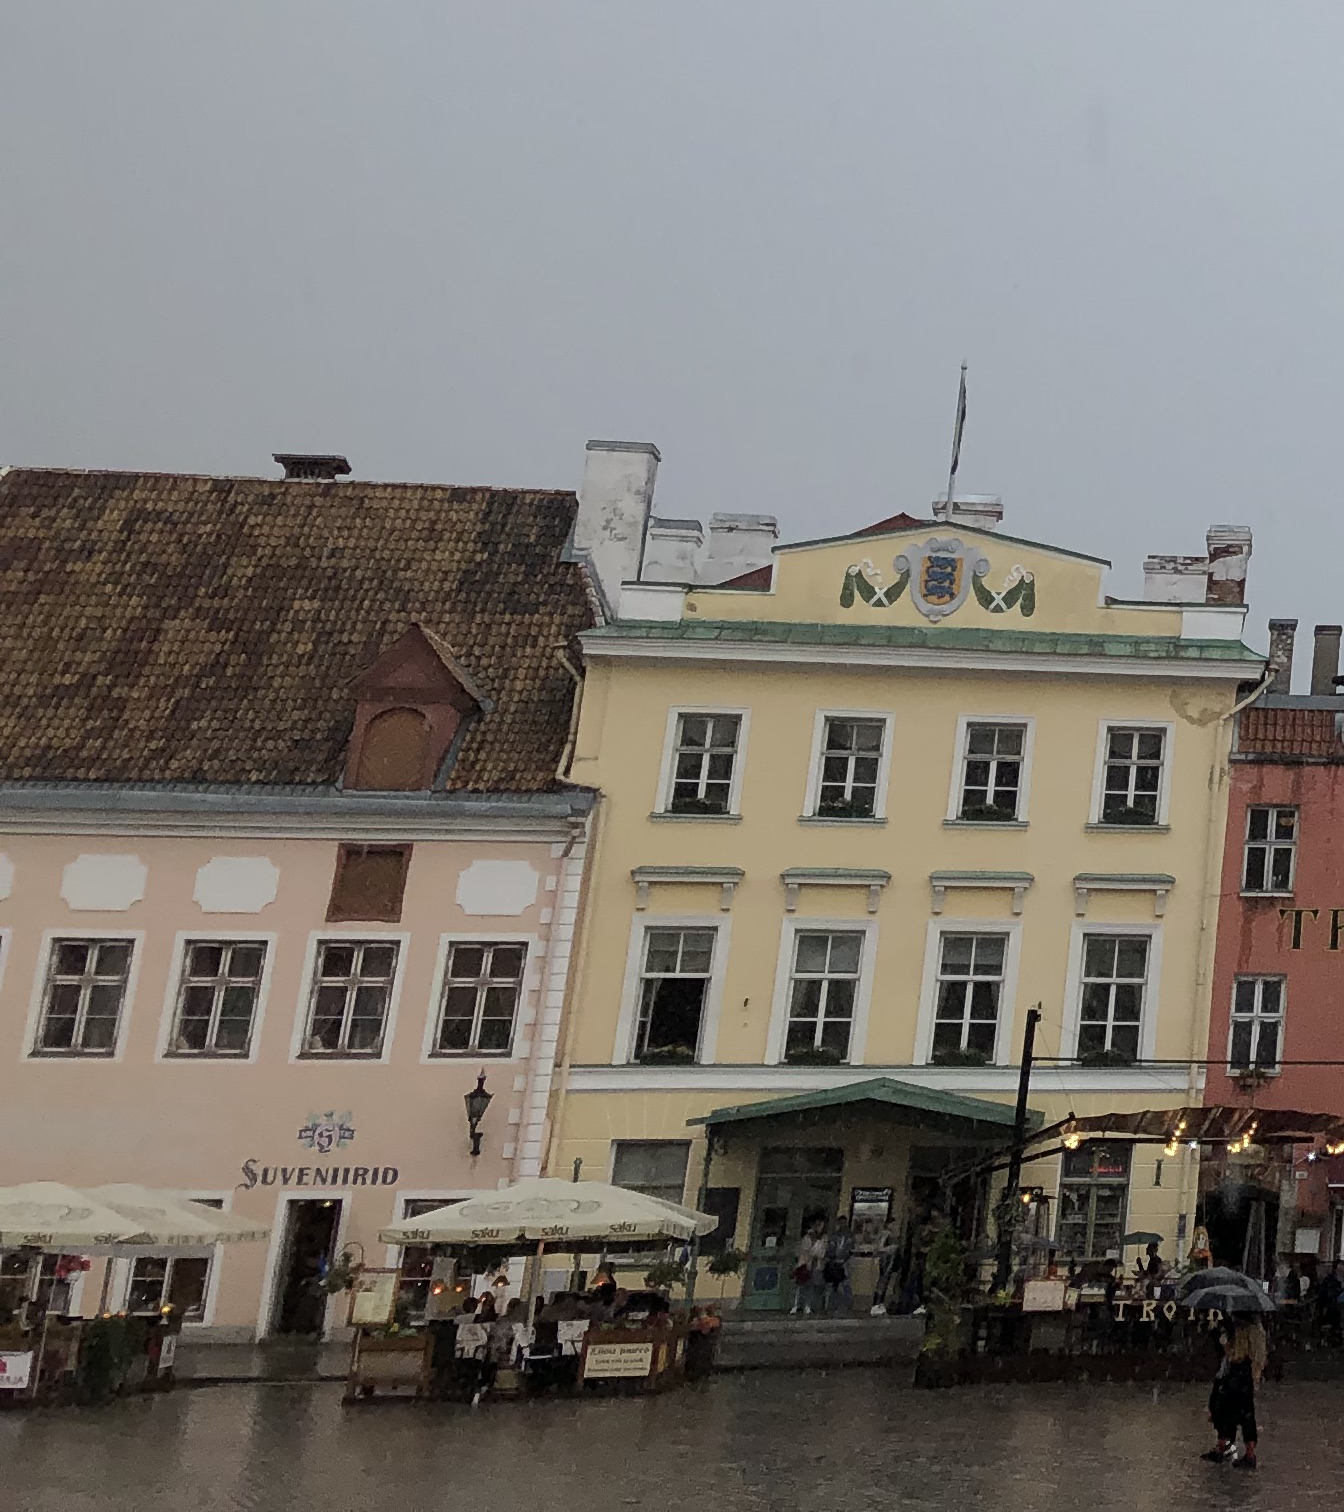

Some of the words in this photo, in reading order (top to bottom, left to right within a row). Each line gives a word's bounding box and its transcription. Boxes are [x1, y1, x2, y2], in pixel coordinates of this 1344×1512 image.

[235, 1159, 399, 1192] SUVENIIRID
[472, 1228, 500, 1239] saku
[542, 1224, 569, 1237] saku
[609, 1221, 637, 1234] saku
